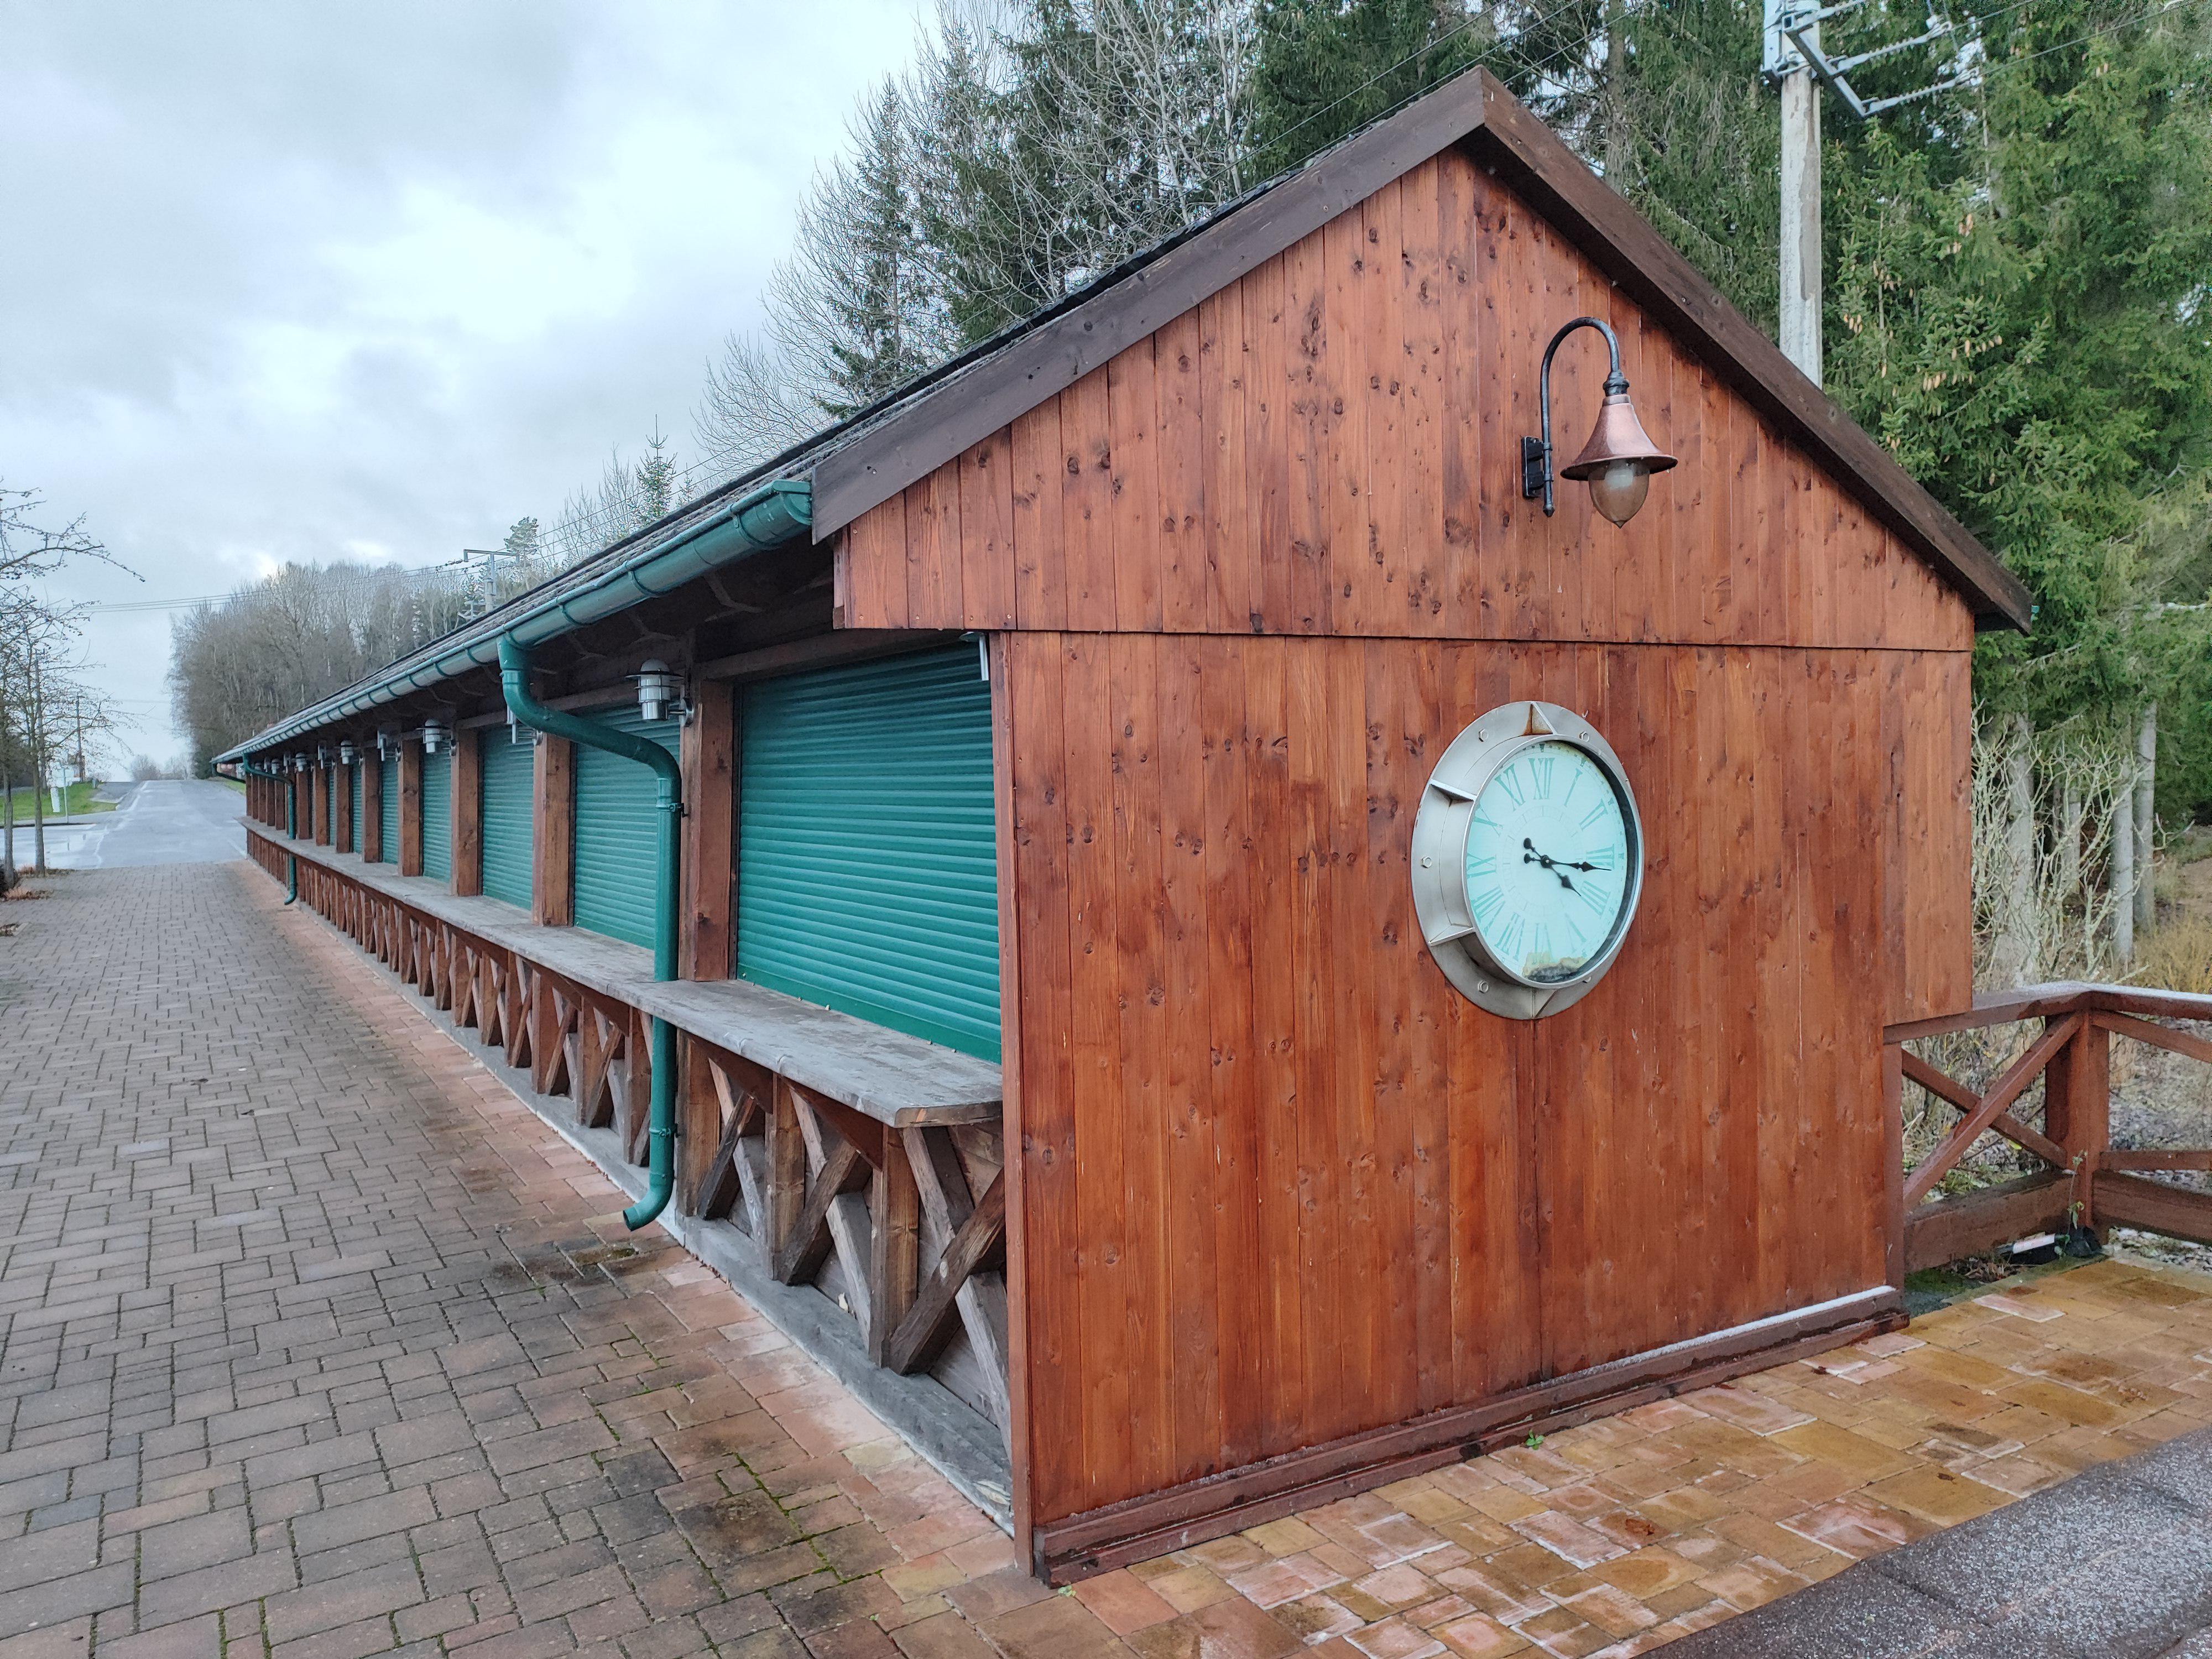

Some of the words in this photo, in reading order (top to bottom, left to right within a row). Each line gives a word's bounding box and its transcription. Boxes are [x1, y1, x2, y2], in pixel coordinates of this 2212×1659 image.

[1495, 763, 1526, 812] XI
[1528, 758, 1555, 800] XII
[1564, 768, 1583, 807] I
[1579, 798, 1609, 832] II
[1585, 843, 1615, 870] III
[1470, 885, 1505, 937] VIII
[1579, 880, 1610, 920] IIII
[1494, 911, 1525, 962] VII
